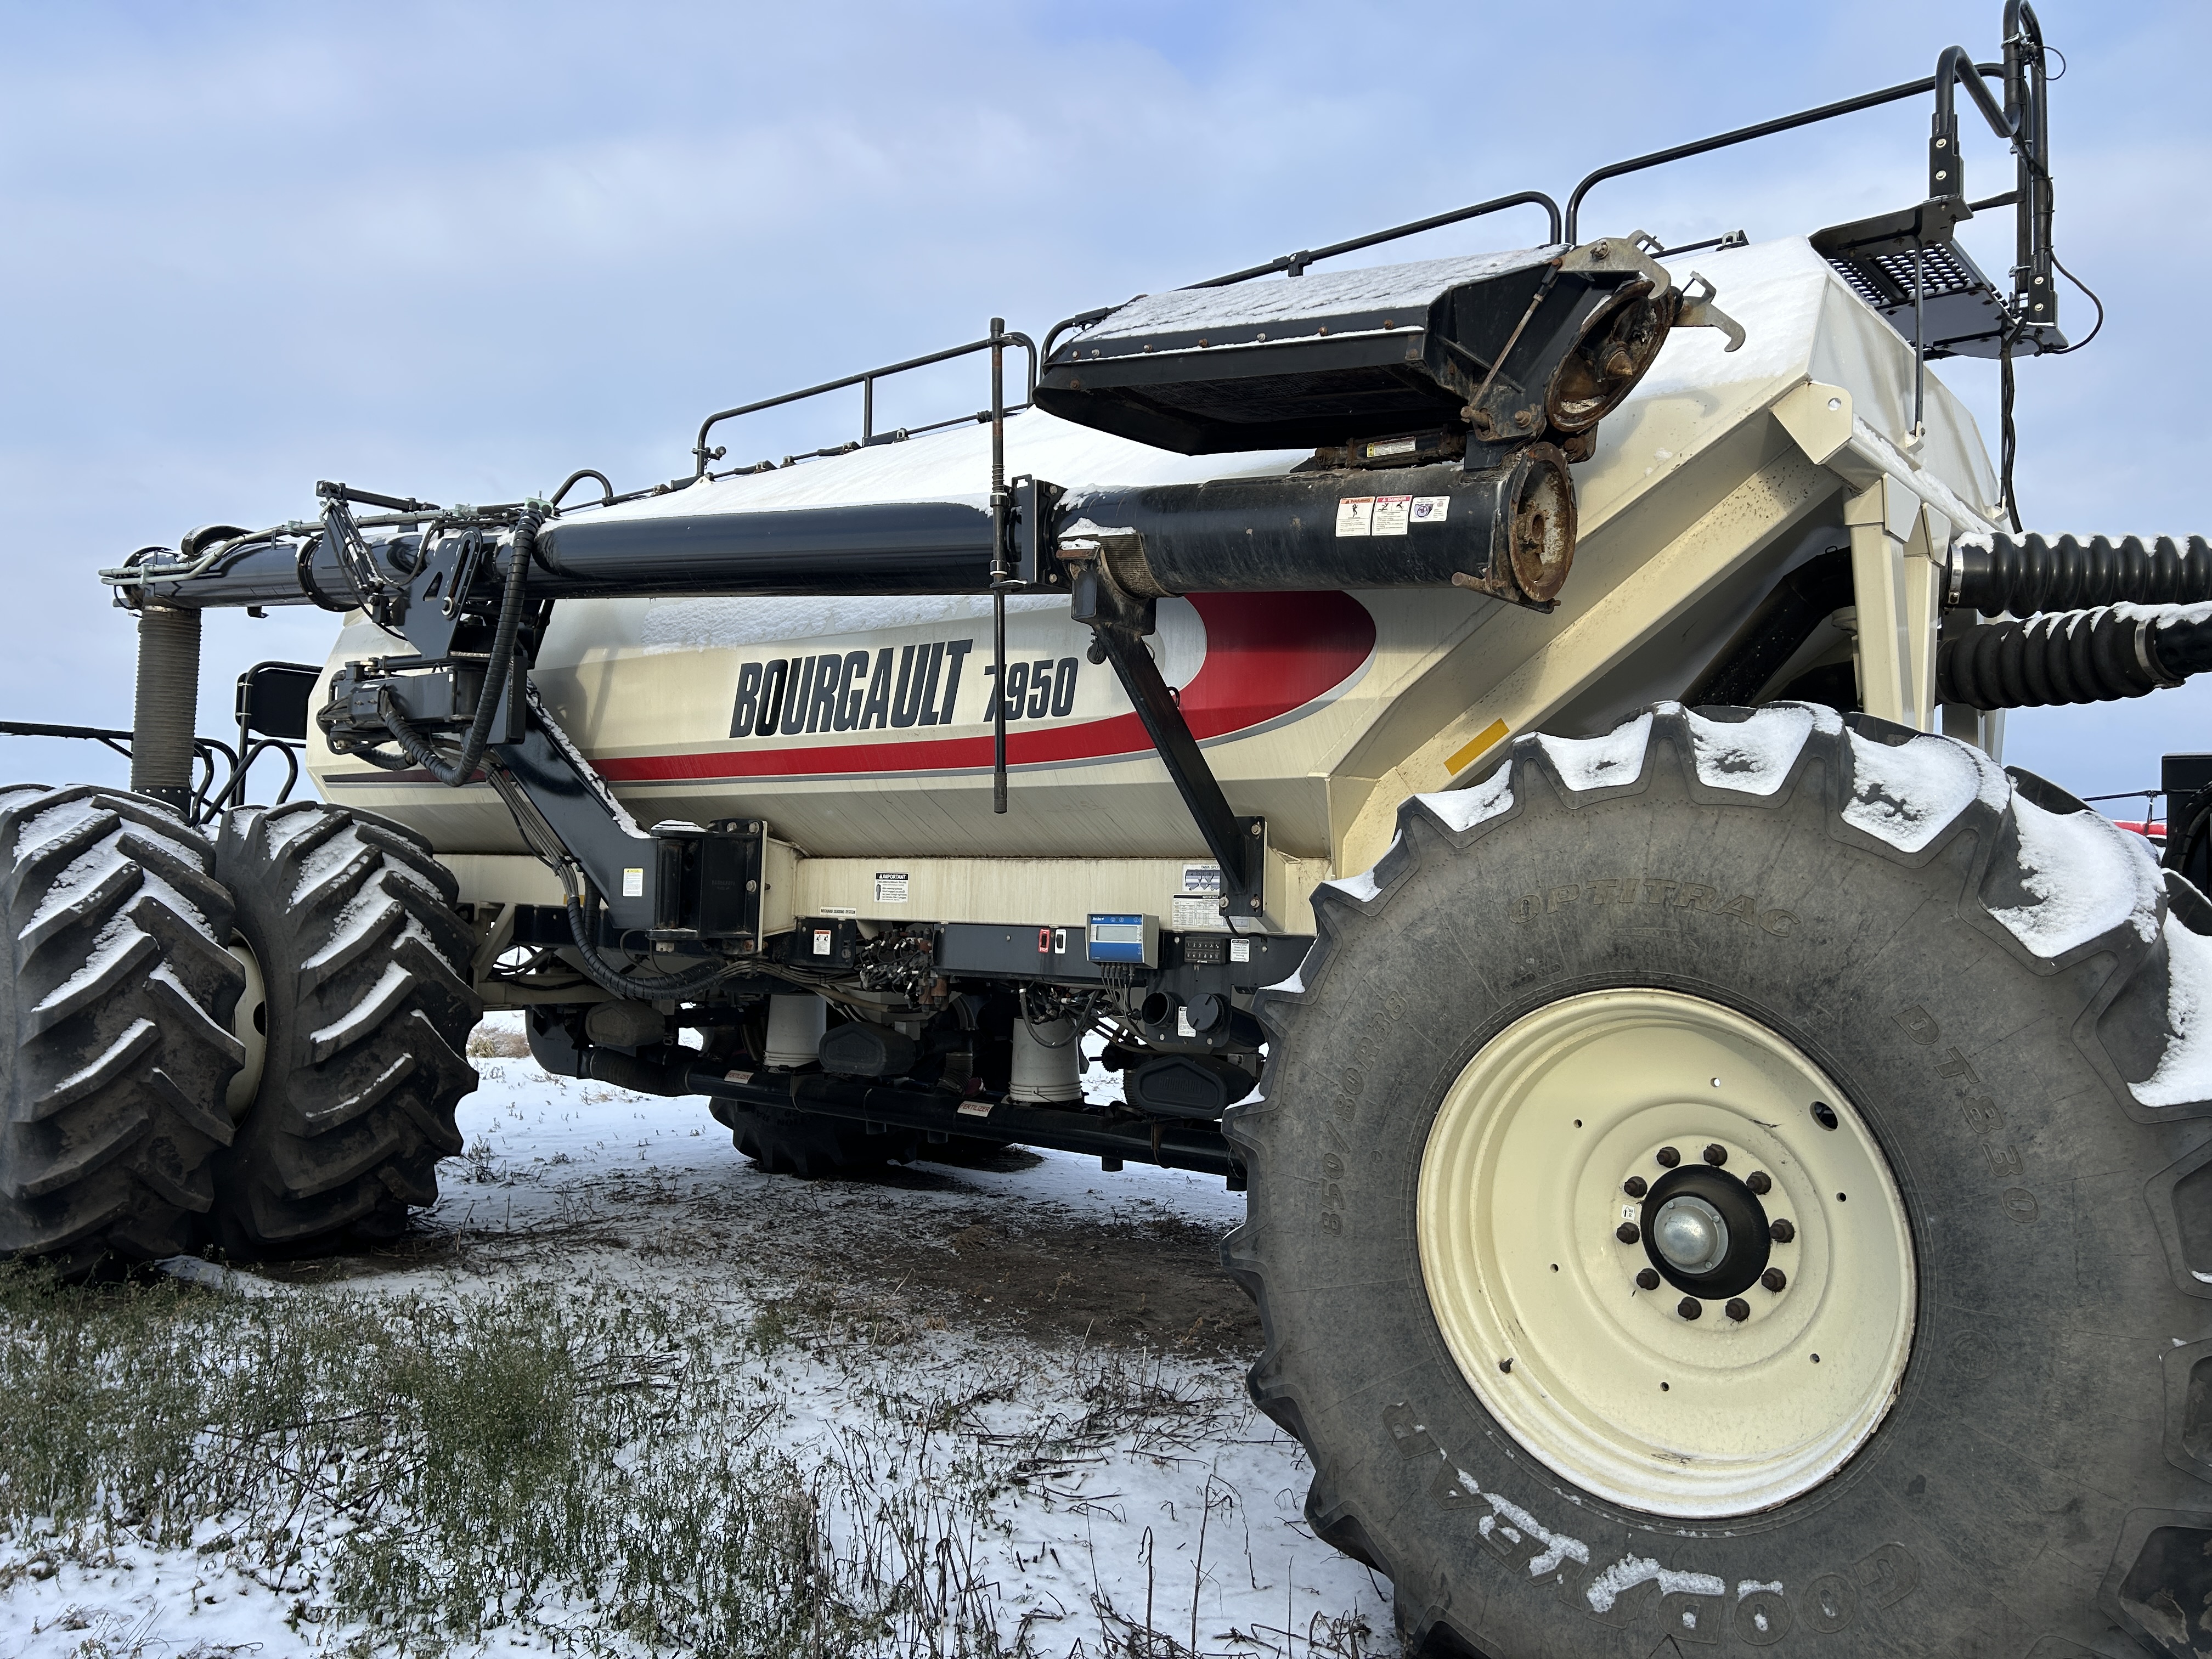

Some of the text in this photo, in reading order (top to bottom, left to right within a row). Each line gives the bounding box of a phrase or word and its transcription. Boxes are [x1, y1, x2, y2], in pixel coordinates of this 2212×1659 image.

[729, 639, 1079, 738] BOURGAULT 7950
[1507, 877, 1802, 938] OPTITRAC
[960, 1103, 991, 1113] FERTILIZER
[1158, 1077, 1204, 1094] BOURGAULT
[1319, 990, 1409, 1237] 850/80R38
